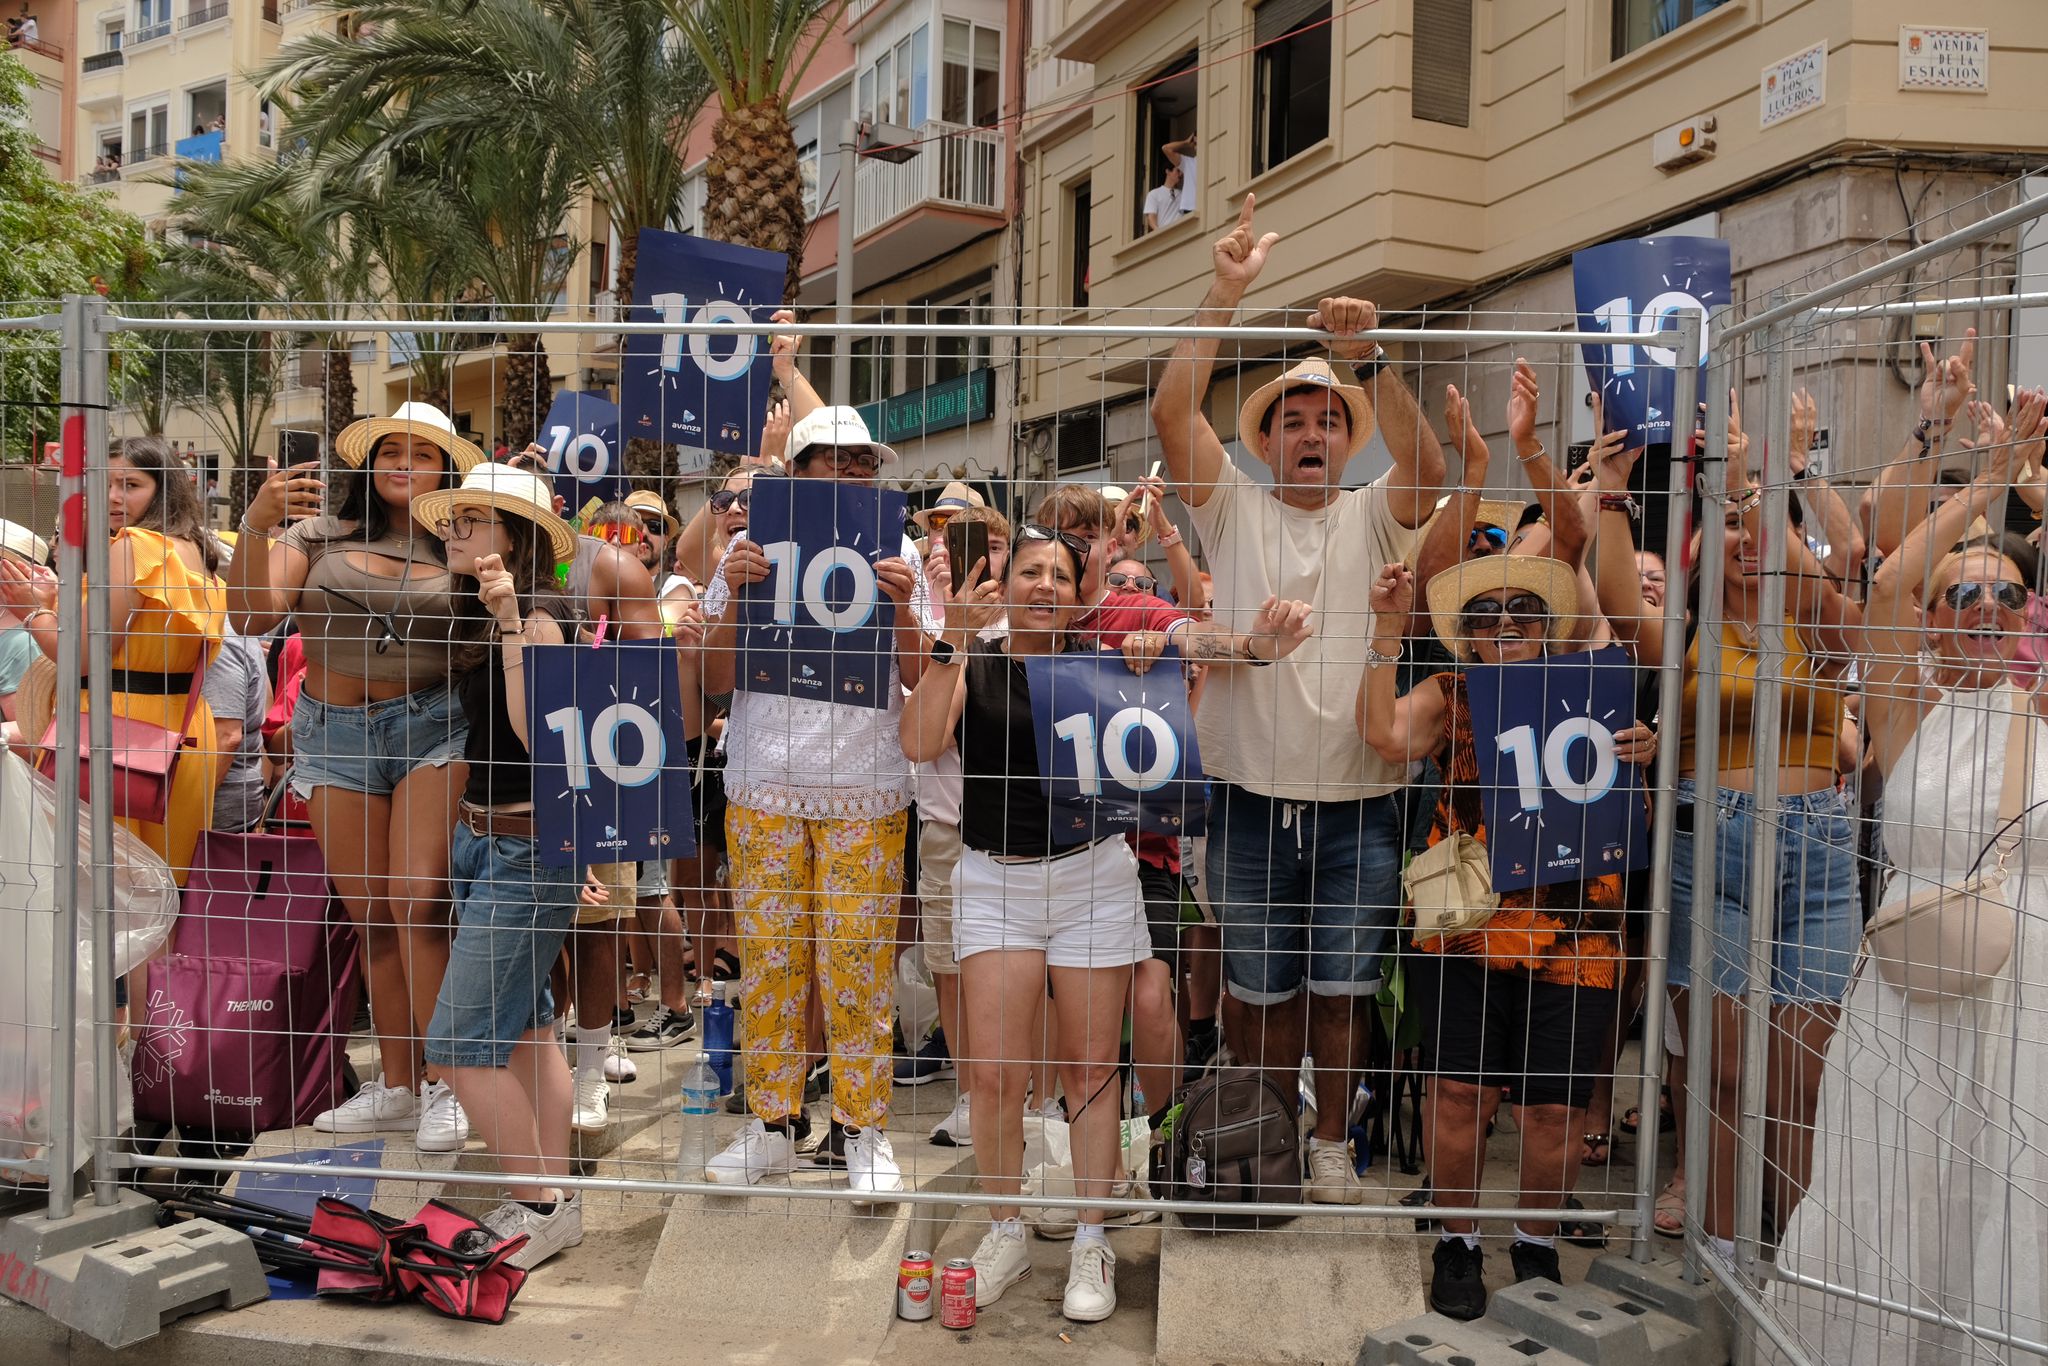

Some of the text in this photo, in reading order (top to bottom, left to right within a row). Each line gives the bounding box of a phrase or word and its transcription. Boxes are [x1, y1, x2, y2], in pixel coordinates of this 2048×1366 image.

[1933, 40, 1978, 52] AVENIDA
[1939, 54, 1973, 66] DE LA
[1783, 60, 1814, 82] PLAZA
[1909, 65, 1980, 79] ESTACION
[1782, 80, 1801, 95] LOS
[1769, 86, 1814, 113] LUCEROS
[651, 292, 758, 381] 10
[1594, 291, 1709, 376] 10
[672, 422, 701, 433] avanza
[1637, 420, 1671, 431] avanza
[547, 425, 610, 484] 10
[763, 541, 878, 633] 10
[791, 676, 823, 687] avanza
[545, 703, 666, 789] 10
[1054, 707, 1179, 796] 10
[1495, 717, 1619, 811] 10
[596, 839, 628, 848] avanza
[1547, 857, 1580, 868] avanza
[226, 1000, 274, 1012] THERMO
[214, 1096, 263, 1106] ROLSER
